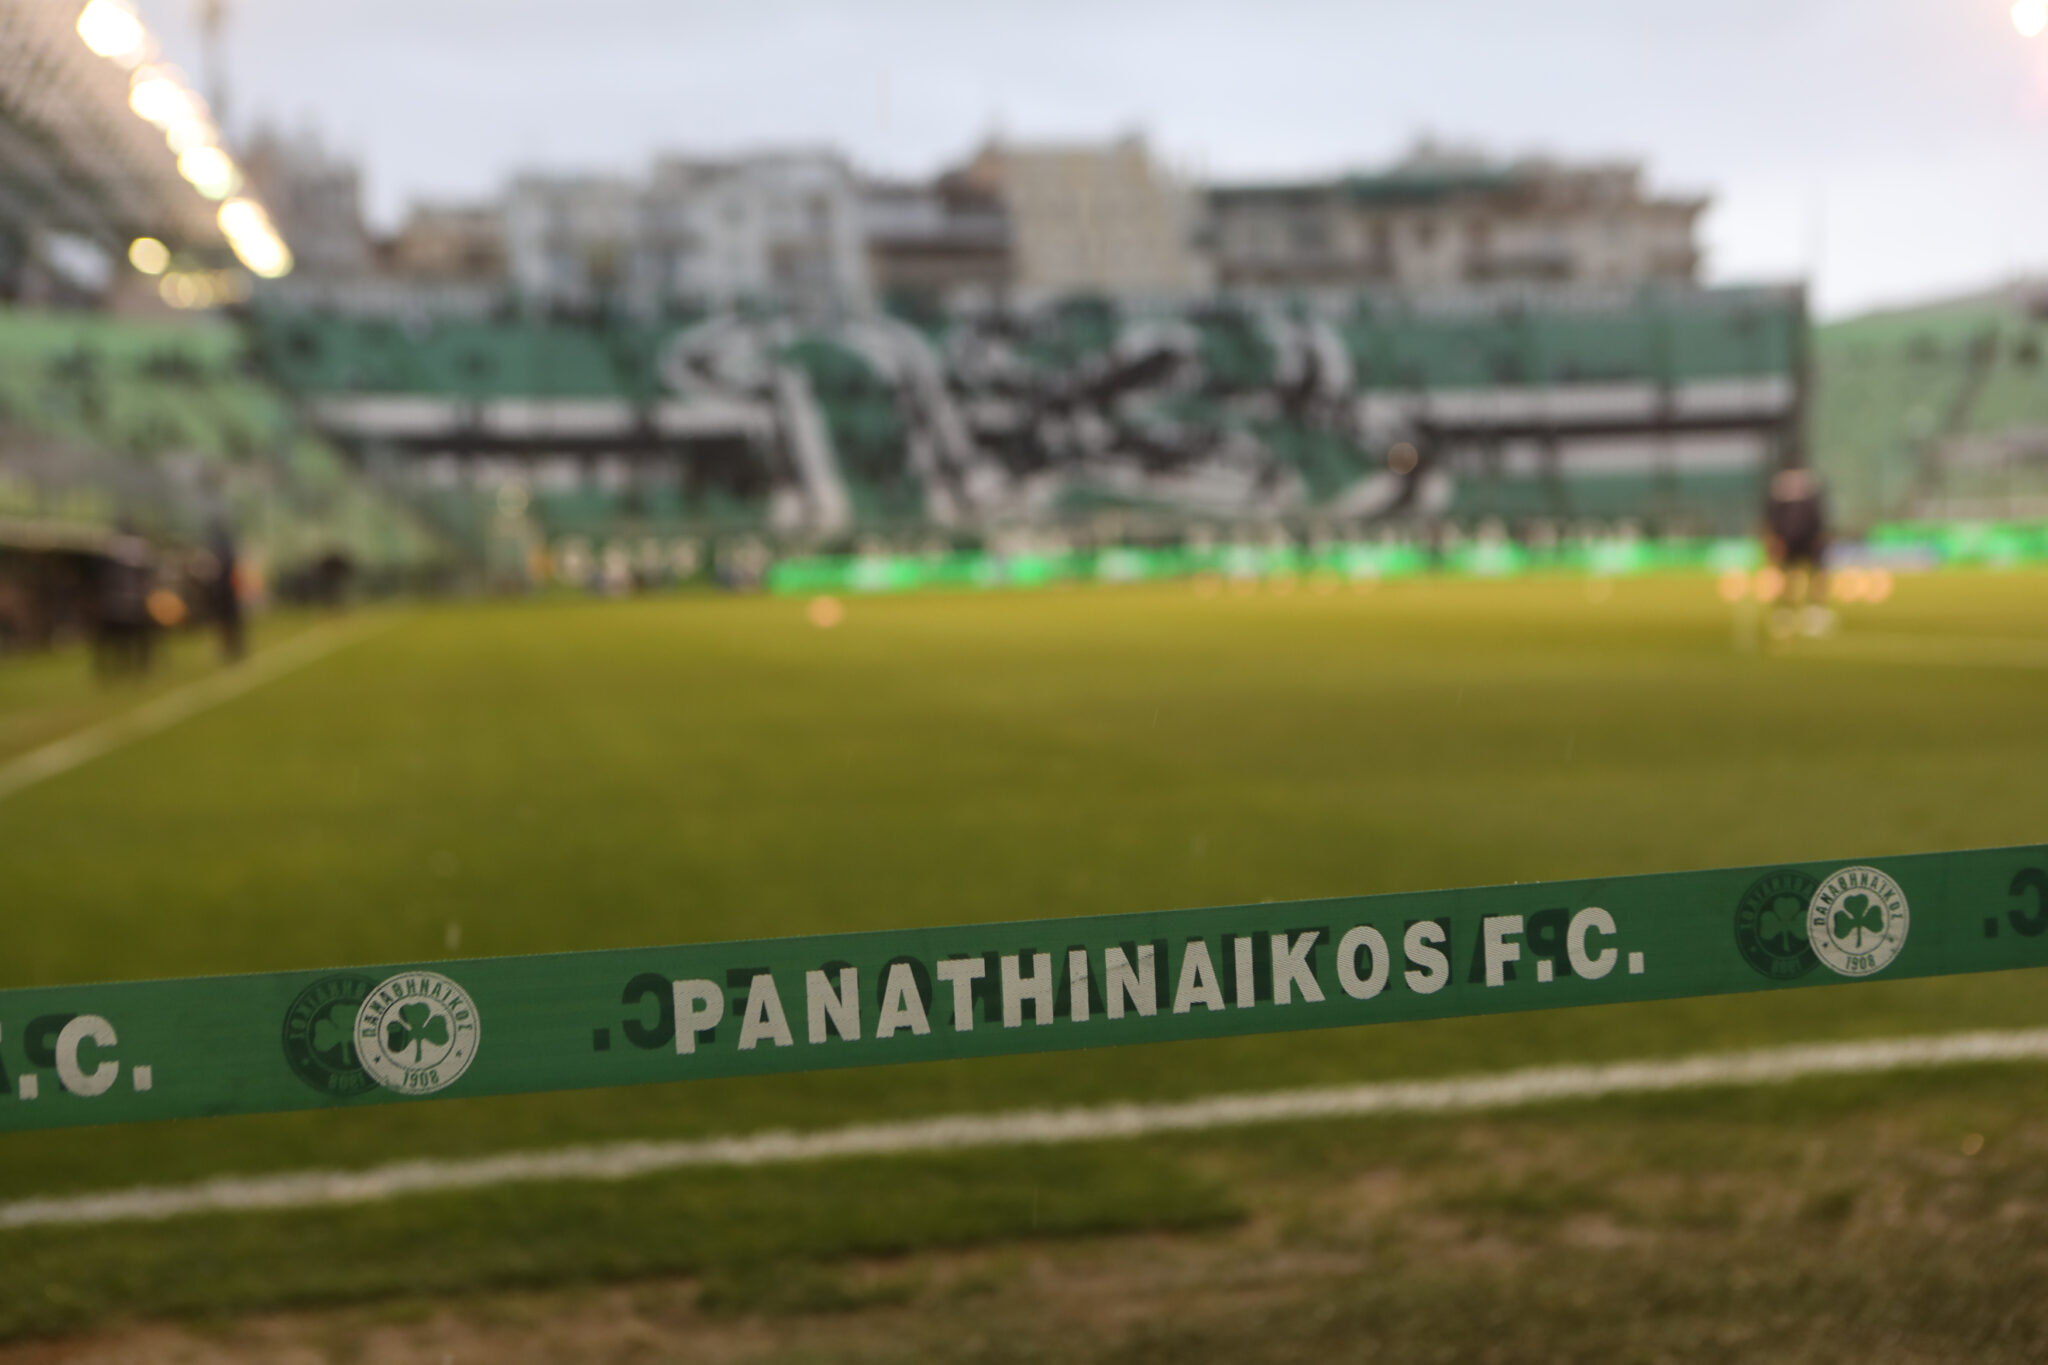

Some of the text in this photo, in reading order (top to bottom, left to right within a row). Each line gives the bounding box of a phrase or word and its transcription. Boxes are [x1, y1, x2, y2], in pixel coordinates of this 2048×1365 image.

[671, 920, 1451, 1055] PANATHINAIKOS
[1483, 906, 1645, 988] F.C.
[1845, 954, 1876, 970] 1908
[0, 1014, 152, 1100] .C.
[402, 1069, 439, 1088] 1908
